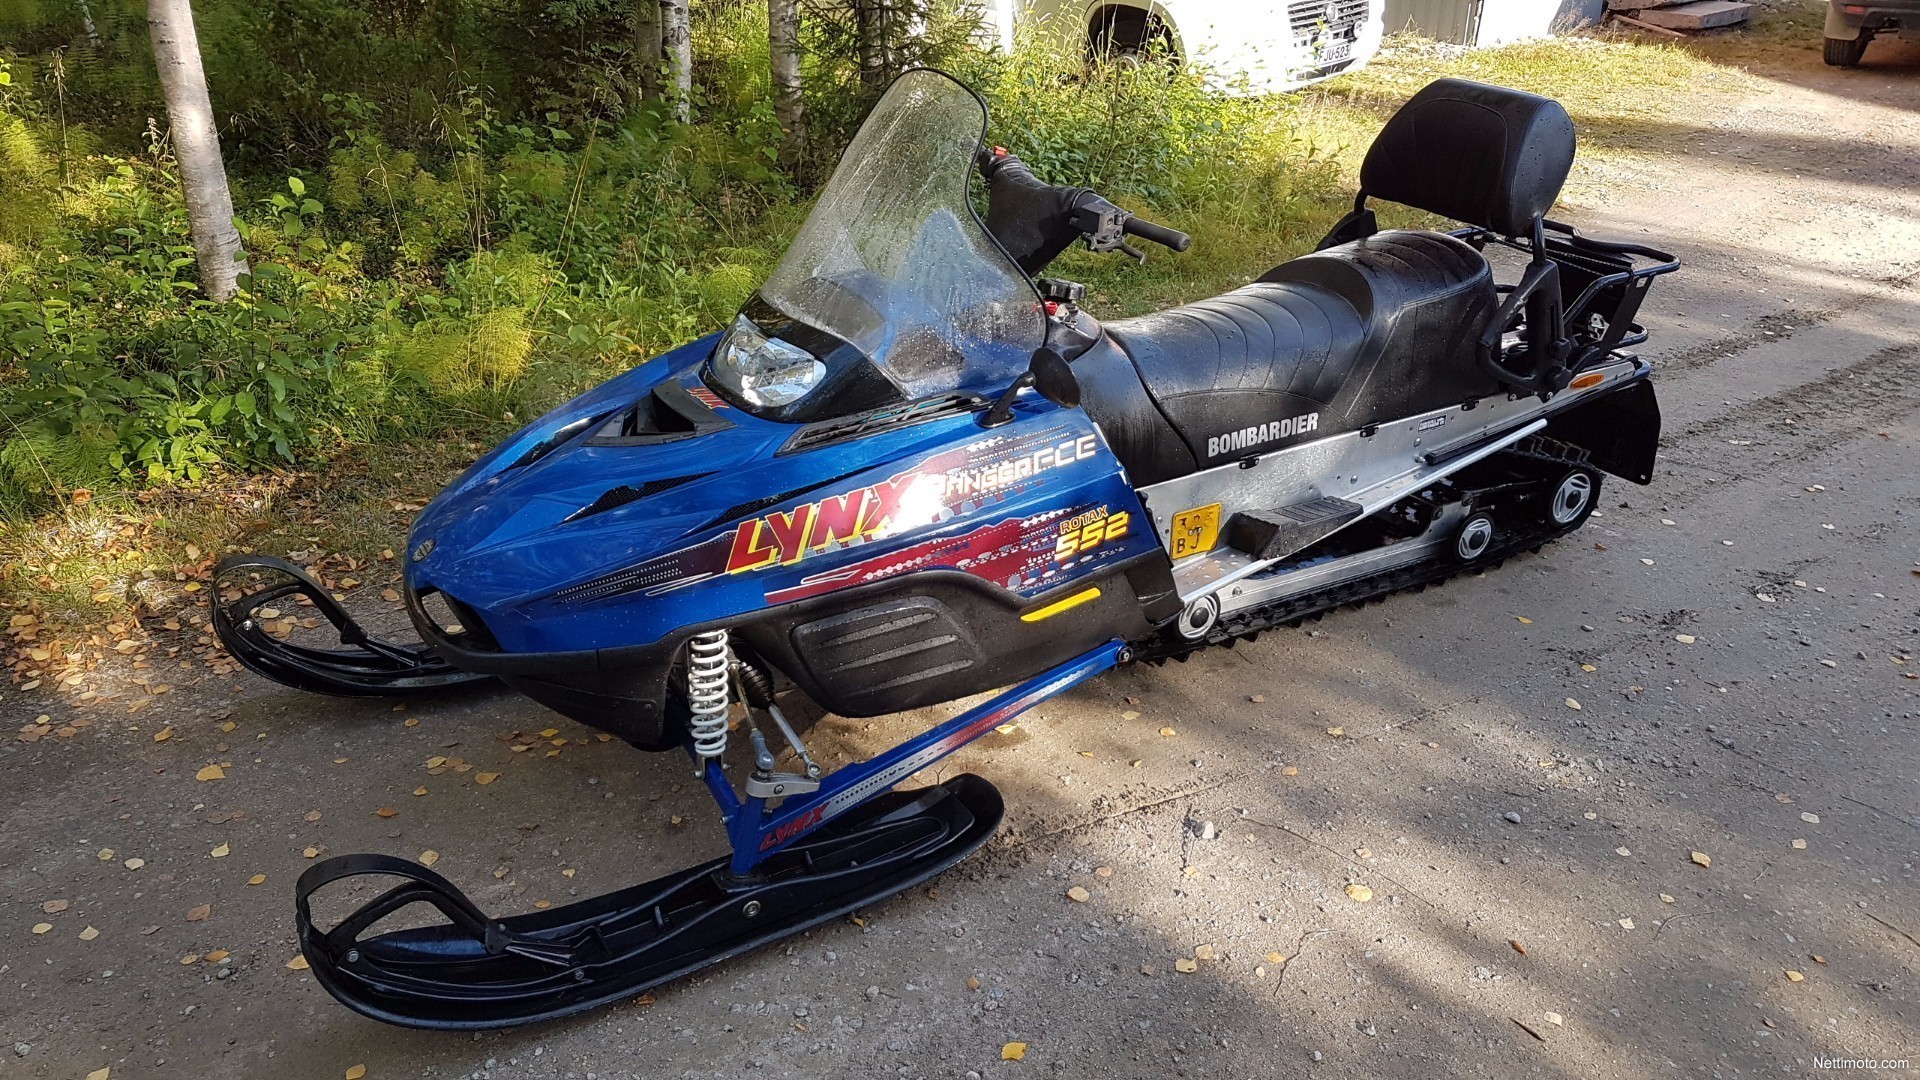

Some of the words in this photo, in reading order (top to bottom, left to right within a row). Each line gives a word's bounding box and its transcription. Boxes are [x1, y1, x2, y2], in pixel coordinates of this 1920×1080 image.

[1208, 412, 1319, 458] BOMBARDIER
[725, 470, 924, 575] LYNX
[1054, 511, 1130, 562] 552
[1060, 504, 1109, 535] ROTAX
[759, 801, 831, 852] LYNX
